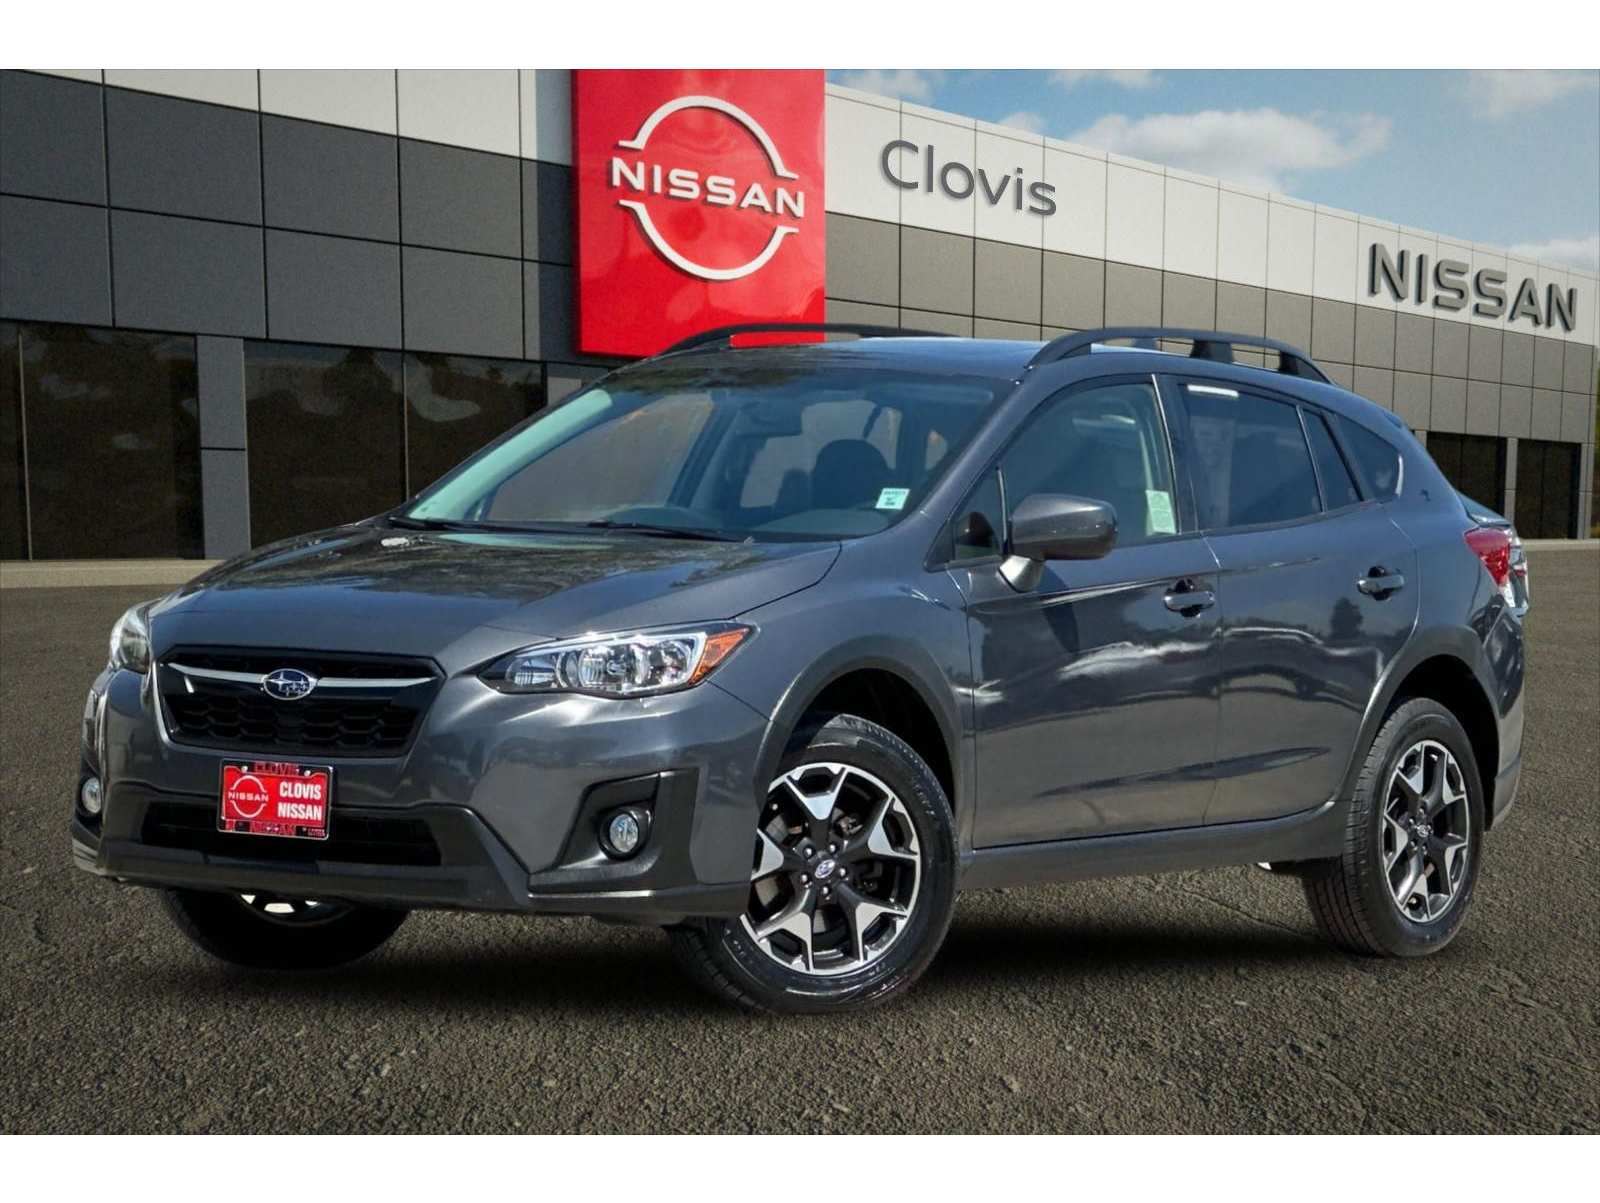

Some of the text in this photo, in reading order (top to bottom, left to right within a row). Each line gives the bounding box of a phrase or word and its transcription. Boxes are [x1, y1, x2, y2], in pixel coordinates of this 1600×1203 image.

[611, 156, 805, 218] NISSAN
[881, 139, 1057, 216] Clovis
[1368, 242, 1578, 333] NISSAN
[228, 791, 269, 803] NISSAN
[279, 781, 322, 800] CLOVIS
[277, 802, 323, 821] NISSAN
